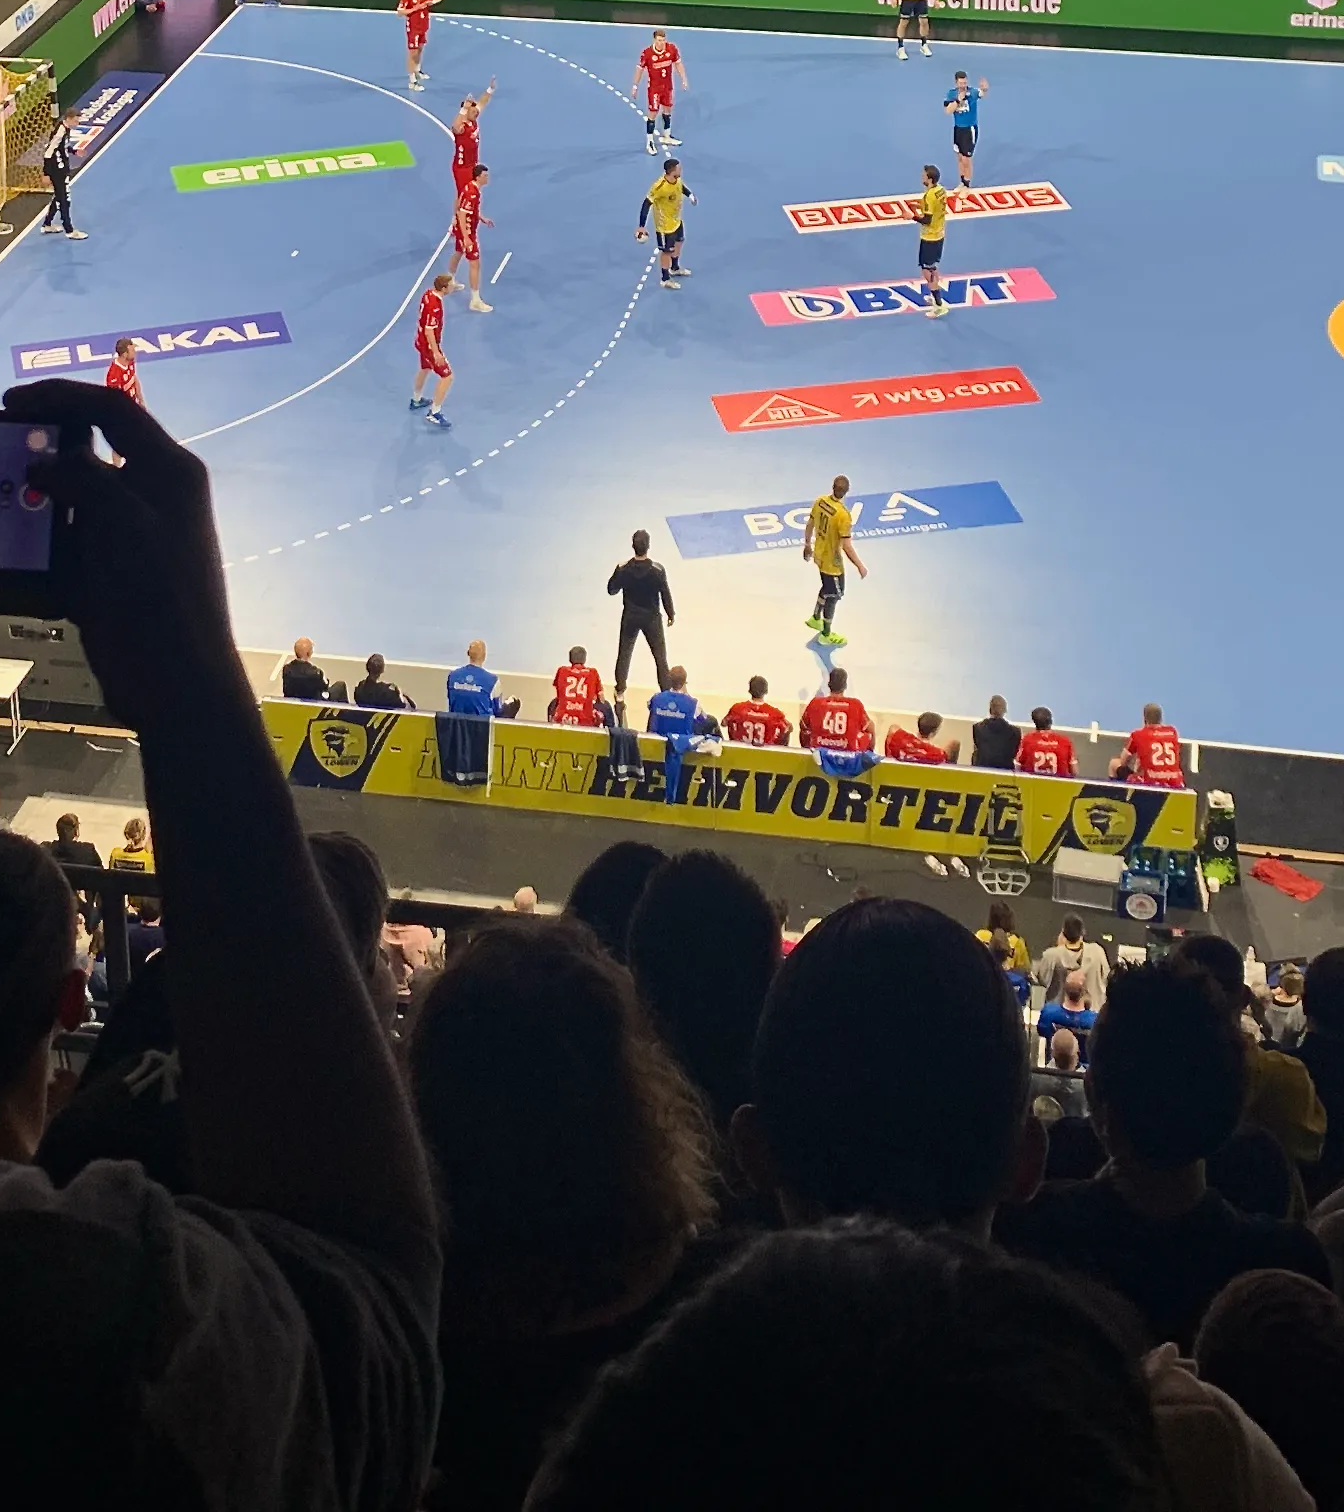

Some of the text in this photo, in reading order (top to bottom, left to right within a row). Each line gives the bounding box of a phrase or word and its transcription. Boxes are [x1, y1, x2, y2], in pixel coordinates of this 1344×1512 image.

[202, 150, 379, 185] erima
[797, 188, 1057, 226] BAUAUS
[846, 275, 1008, 313] BWT
[883, 377, 1022, 403] wtg.com
[851, 522, 948, 538] rsicherungen
[565, 675, 588, 699] 24
[742, 720, 766, 744] 33
[822, 711, 848, 735] 48
[1033, 750, 1058, 775] 23
[1151, 741, 1176, 766] 25
[417, 737, 1022, 836] NNHEIMVORTEIL
